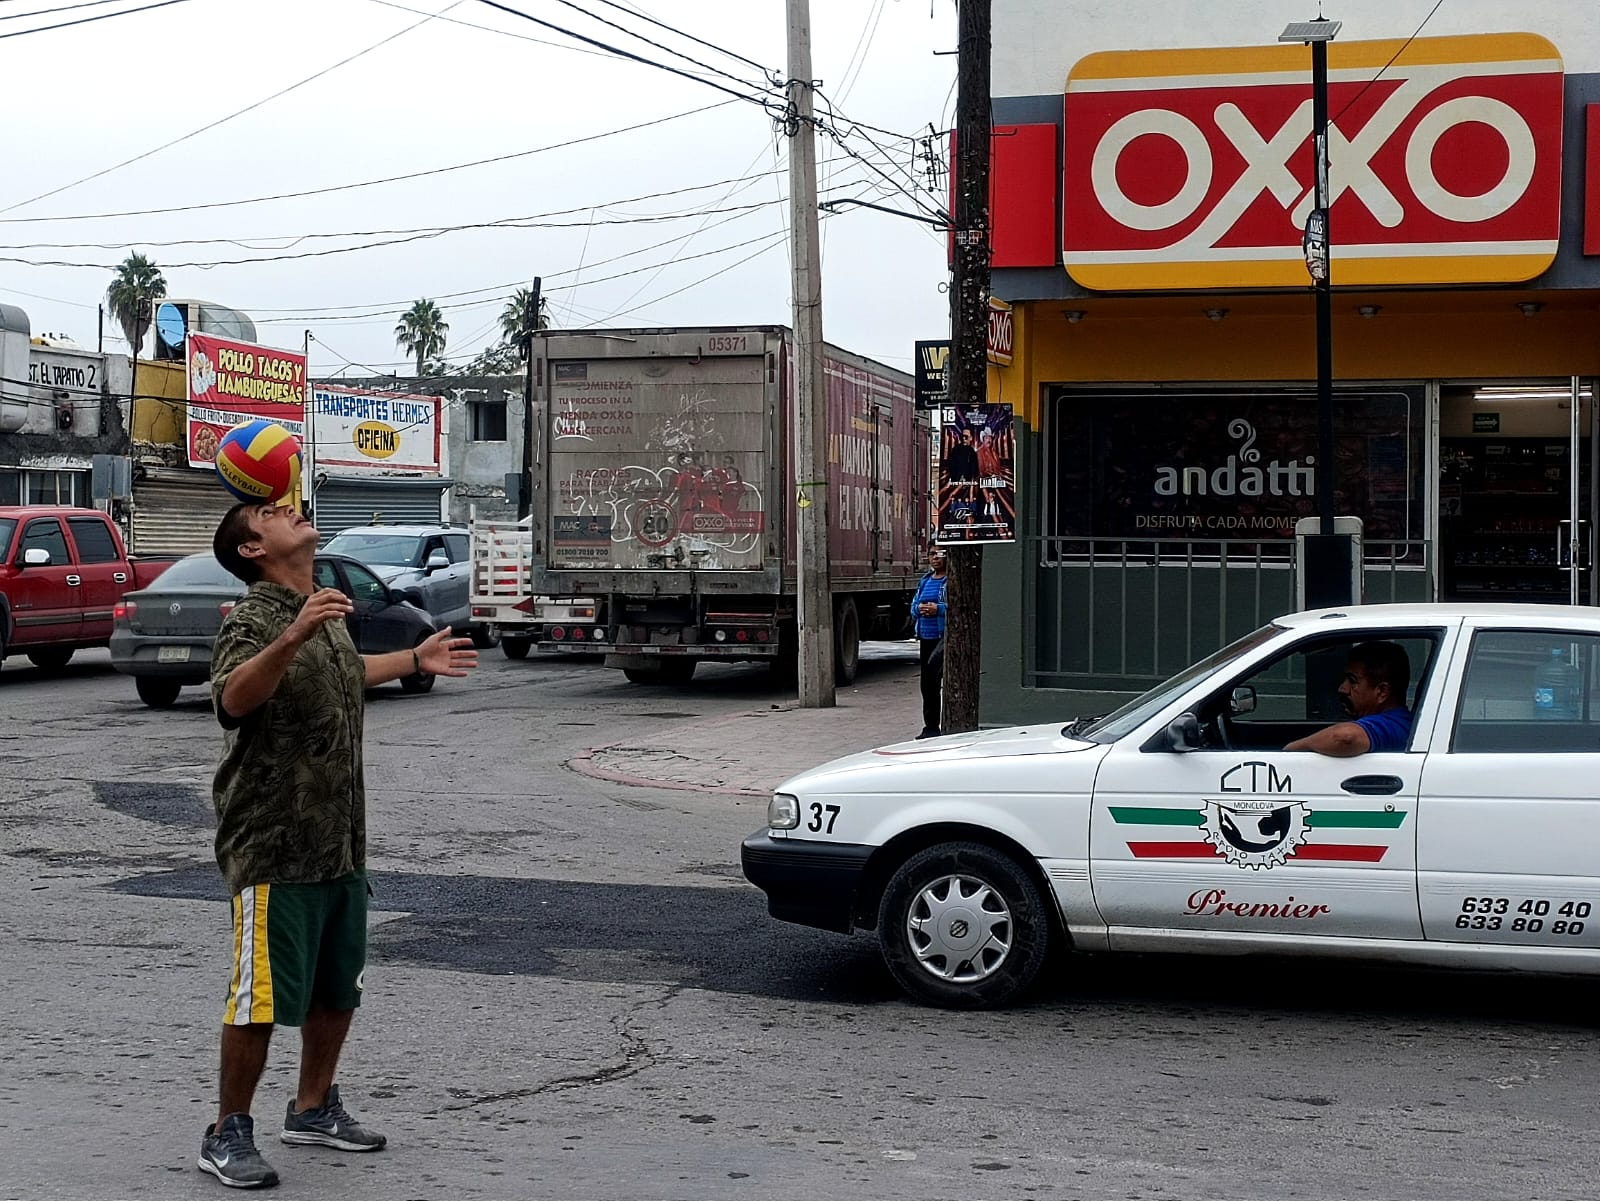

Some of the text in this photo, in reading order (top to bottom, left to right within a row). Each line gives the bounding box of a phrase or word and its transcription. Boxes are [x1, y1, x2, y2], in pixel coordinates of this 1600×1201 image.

[1091, 86, 1536, 249] OXXO
[709, 336, 746, 351] 05371
[988, 311, 1012, 351] OXXO
[41, 362, 51, 384] EL
[53, 366, 85, 387] TAPATIO
[87, 364, 97, 389] 2
[257, 356, 293, 381] TACOS
[294, 363, 303, 383] Y
[217, 373, 303, 406] HAMBURGUESAS
[558, 397, 633, 405] TU PROCESO EN LA
[316, 393, 430, 425] TRANSPORTES HERMES
[560, 411, 633, 420] TIENDA OXXO
[942, 410, 956, 421] 18
[357, 428, 395, 451] OFICINA
[584, 426, 633, 435] CERCANA
[840, 434, 872, 479] VAMOS
[220, 462, 263, 495] VOLLEYBALL
[576, 469, 631, 478] RAZONES
[1154, 455, 1315, 496] andatti
[839, 485, 852, 530] EL
[695, 518, 723, 528] OXXO
[1136, 515, 1202, 528] DISFRUTA
[1206, 515, 1248, 529] CADA
[1220, 761, 1291, 792] CTM
[807, 802, 841, 834] 37
[1212, 832, 1295, 862] RADIO TAXIS
[1183, 888, 1331, 918] Premier
[1462, 897, 1591, 918] 633 40 40
[1455, 914, 1584, 935] 633 80 80
